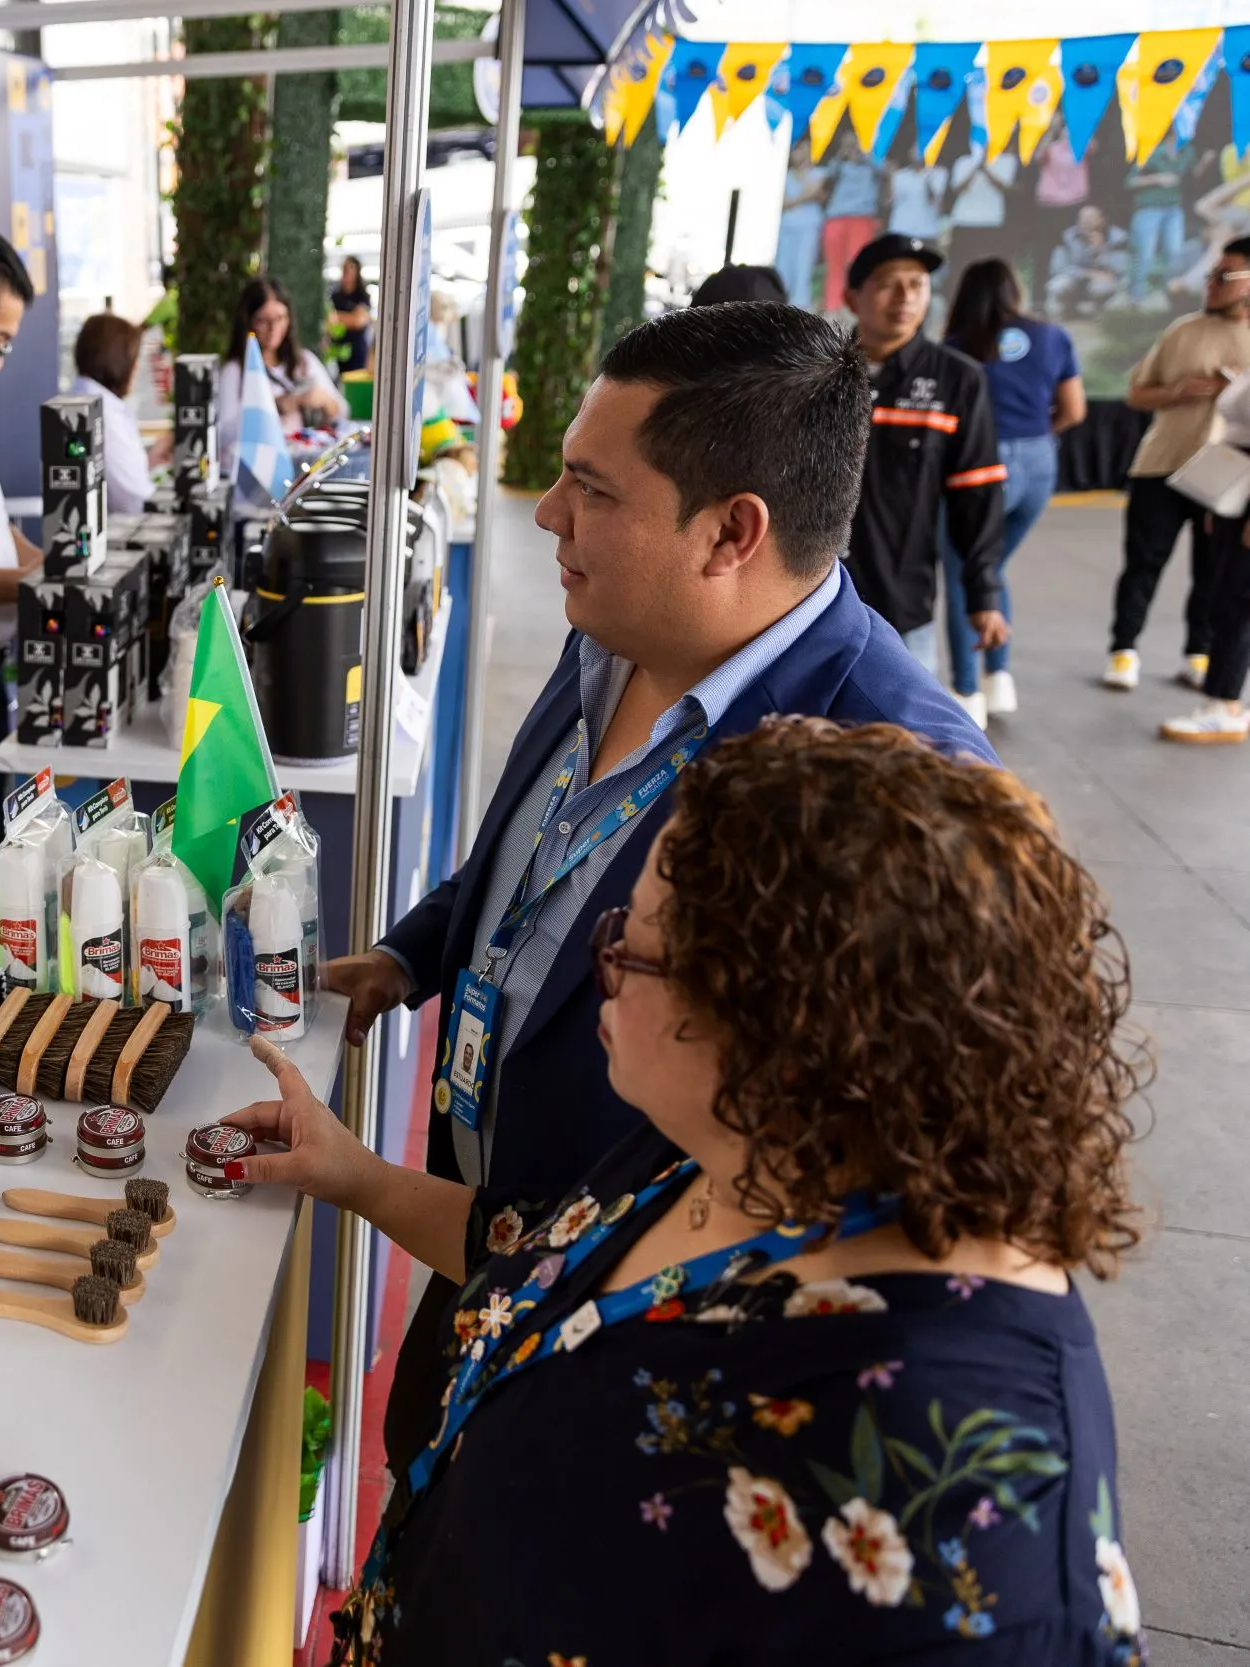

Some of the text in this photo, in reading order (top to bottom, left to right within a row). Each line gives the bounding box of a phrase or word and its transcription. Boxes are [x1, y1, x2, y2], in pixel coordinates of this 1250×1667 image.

[638, 769, 667, 797] FUERZA
[1, 925, 35, 938] Brimas
[87, 943, 120, 956] Brimas
[144, 945, 178, 959] Brimas
[258, 961, 296, 972] Brimas
[465, 983, 481, 998] Super
[1, 1097, 29, 1121] BRIMAS
[101, 1109, 125, 1133] BRIMAS
[20, 1142, 36, 1152] CAFE
[211, 1127, 236, 1153] BRIMAS
[124, 1153, 138, 1164] CAFE
[197, 1173, 213, 1184] CAFE
[5, 1480, 45, 1527] BRIMAS
